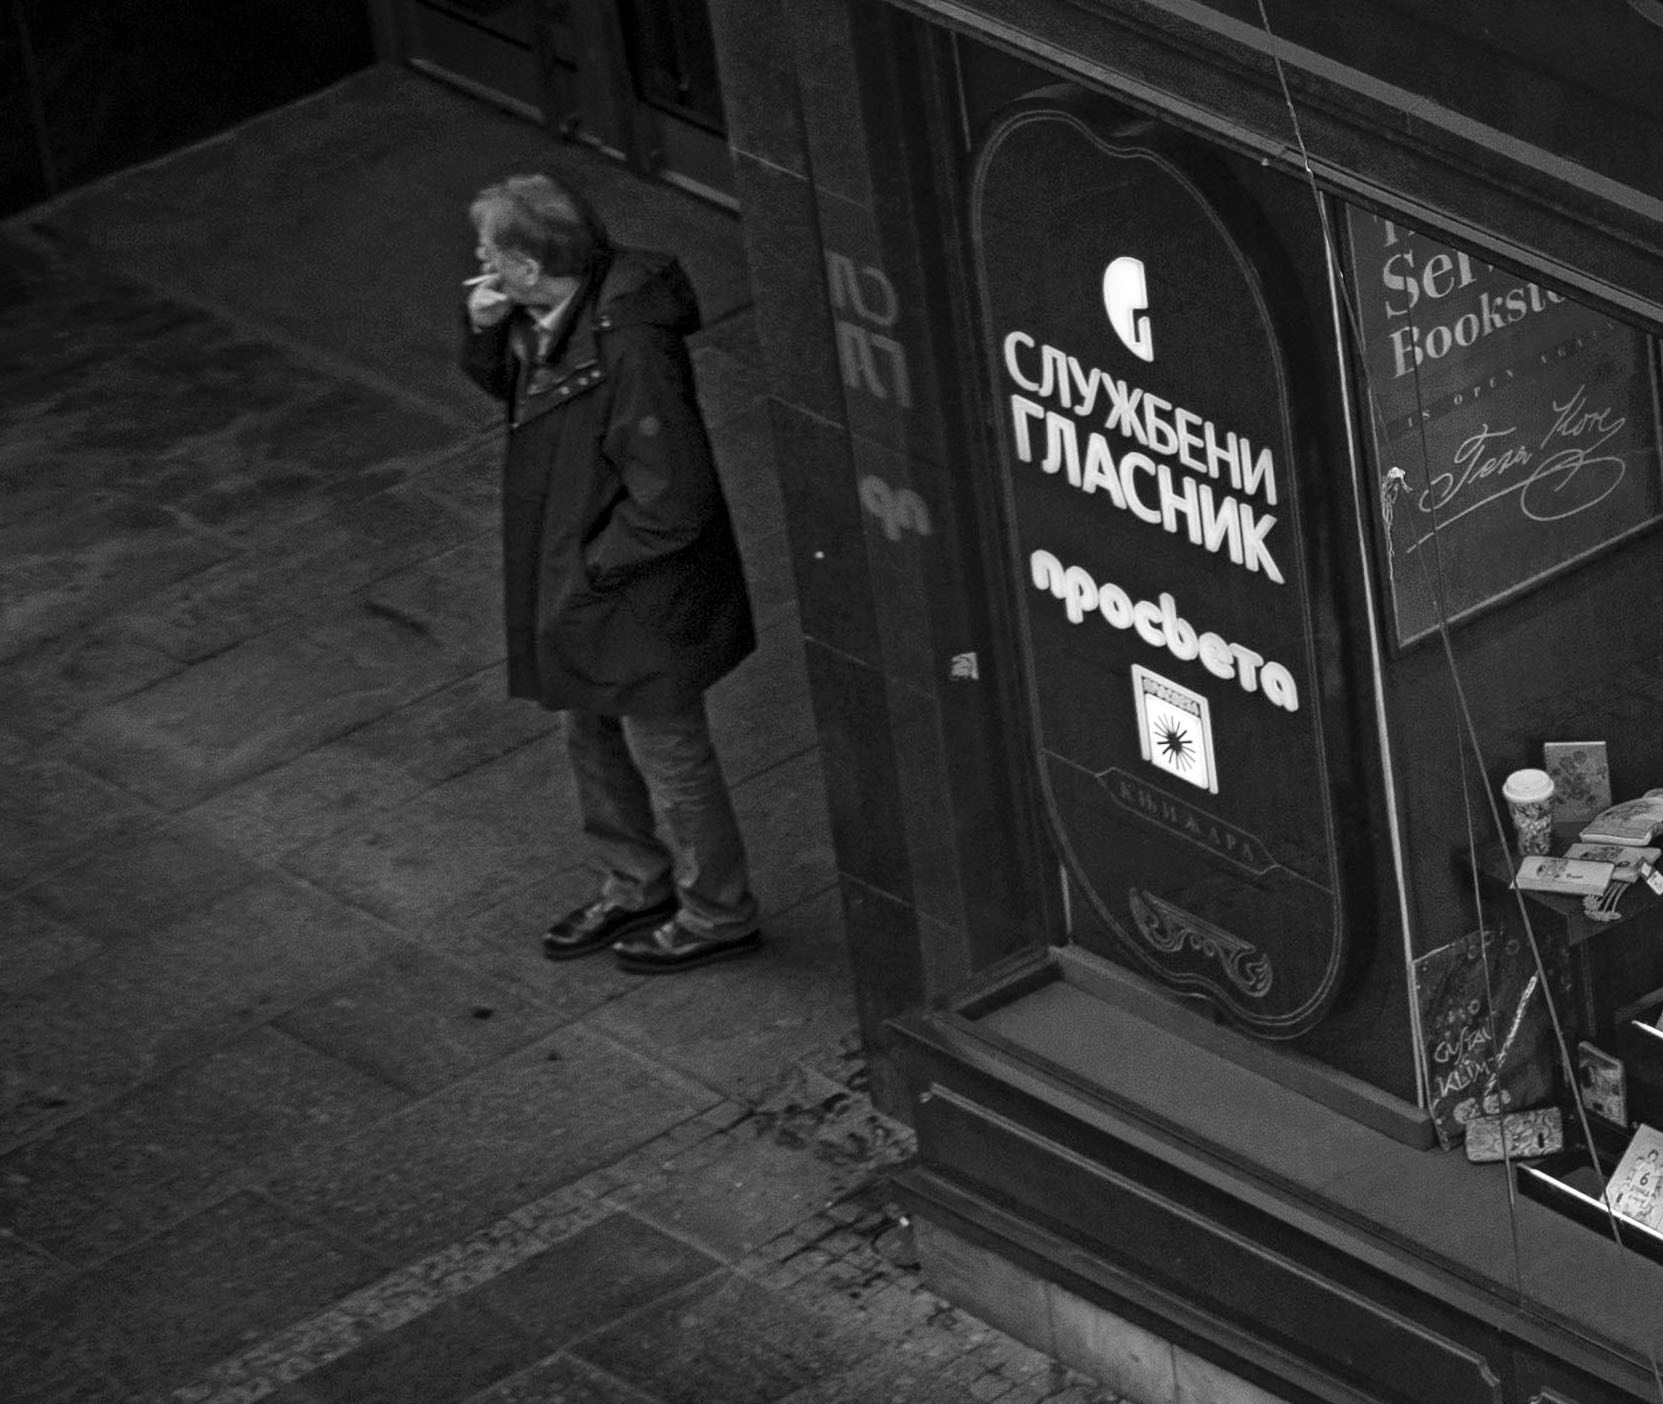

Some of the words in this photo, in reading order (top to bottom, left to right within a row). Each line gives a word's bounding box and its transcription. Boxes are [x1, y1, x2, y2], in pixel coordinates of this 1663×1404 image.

[1003, 330, 1278, 506] СЛУЖБЕНИ
[1011, 393, 1286, 585] ГЛАСНИК
[1640, 1172, 1651, 1187] 6
